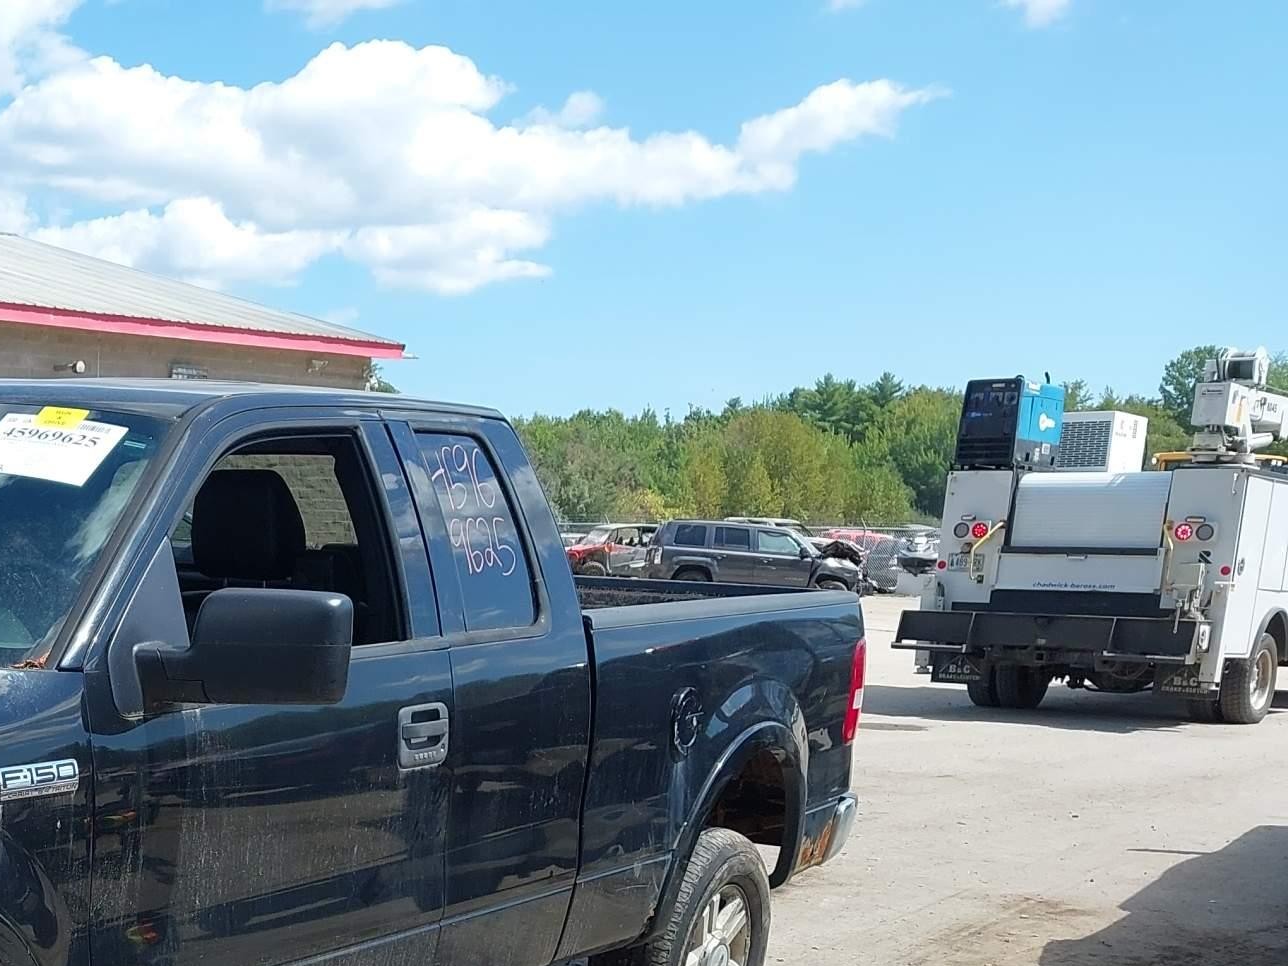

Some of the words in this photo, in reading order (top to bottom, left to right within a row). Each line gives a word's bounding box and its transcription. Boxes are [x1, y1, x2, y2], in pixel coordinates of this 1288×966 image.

[3, 427, 102, 448] 45969625
[422, 444, 496, 511] 4596
[448, 516, 517, 577] 9625
